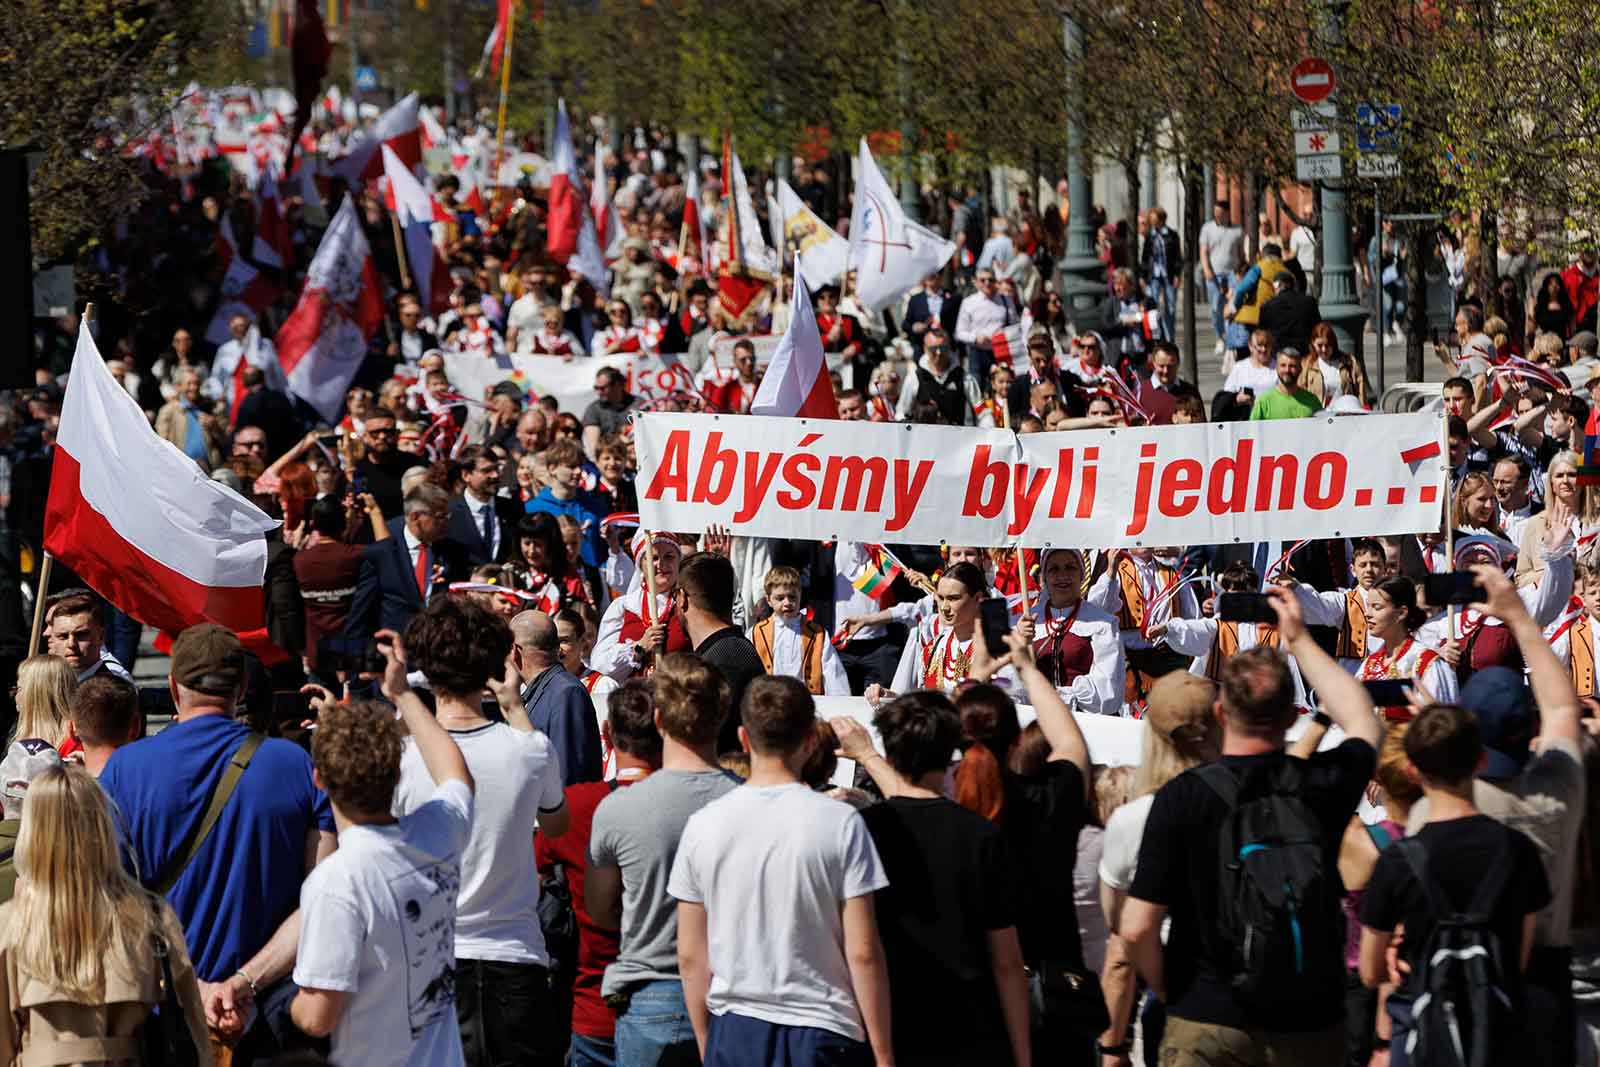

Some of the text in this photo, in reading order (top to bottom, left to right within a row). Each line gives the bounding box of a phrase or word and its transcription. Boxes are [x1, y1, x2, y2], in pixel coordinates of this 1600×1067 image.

[645, 430, 1438, 536] Abyśmy byli jedno...
